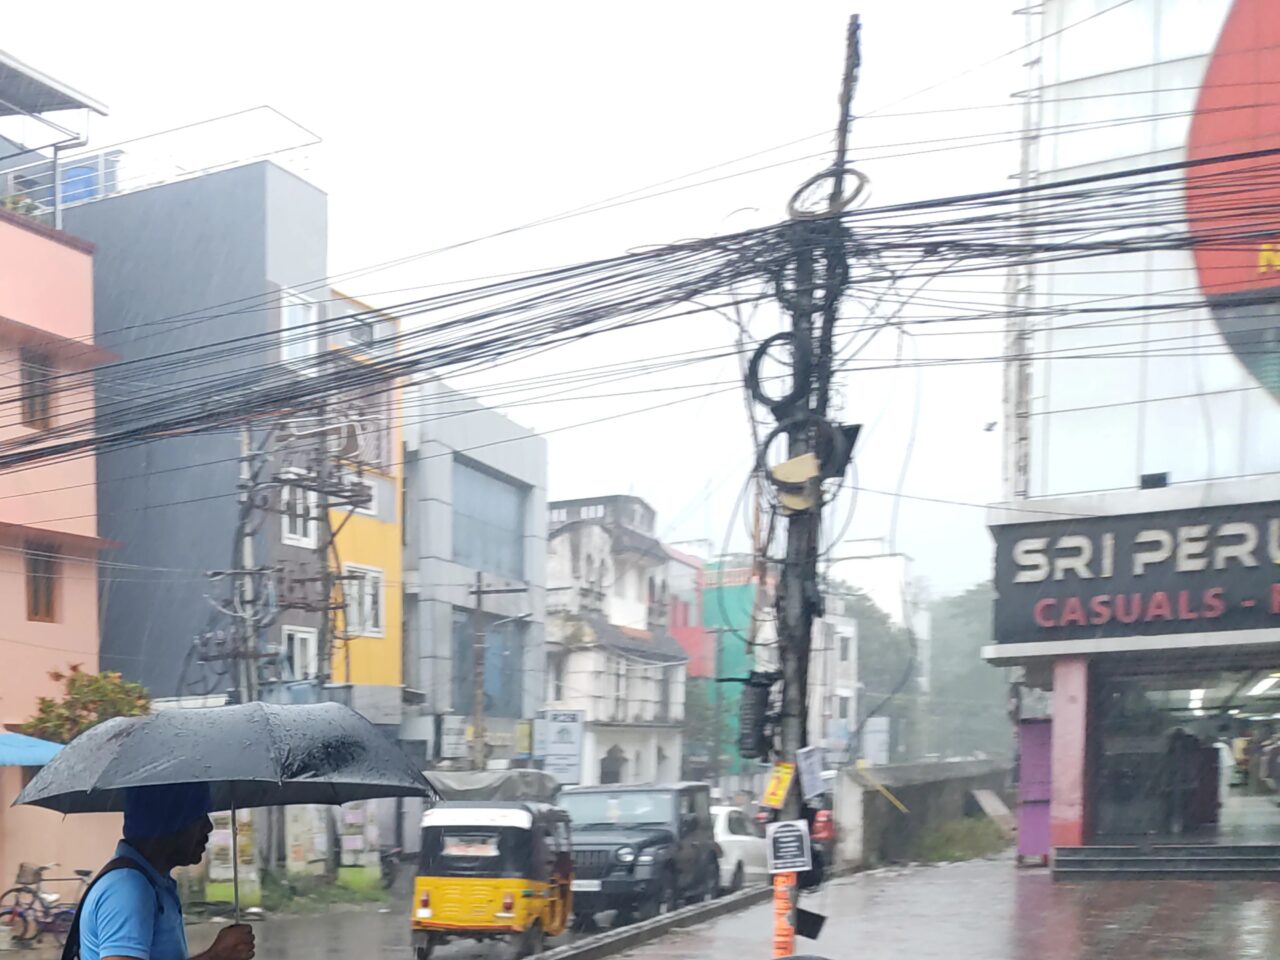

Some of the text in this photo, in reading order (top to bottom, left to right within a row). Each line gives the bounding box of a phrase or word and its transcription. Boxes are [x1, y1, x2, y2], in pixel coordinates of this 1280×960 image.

[1012, 518, 1280, 583] SRI PER
[1033, 587, 1226, 628] CASUALS
